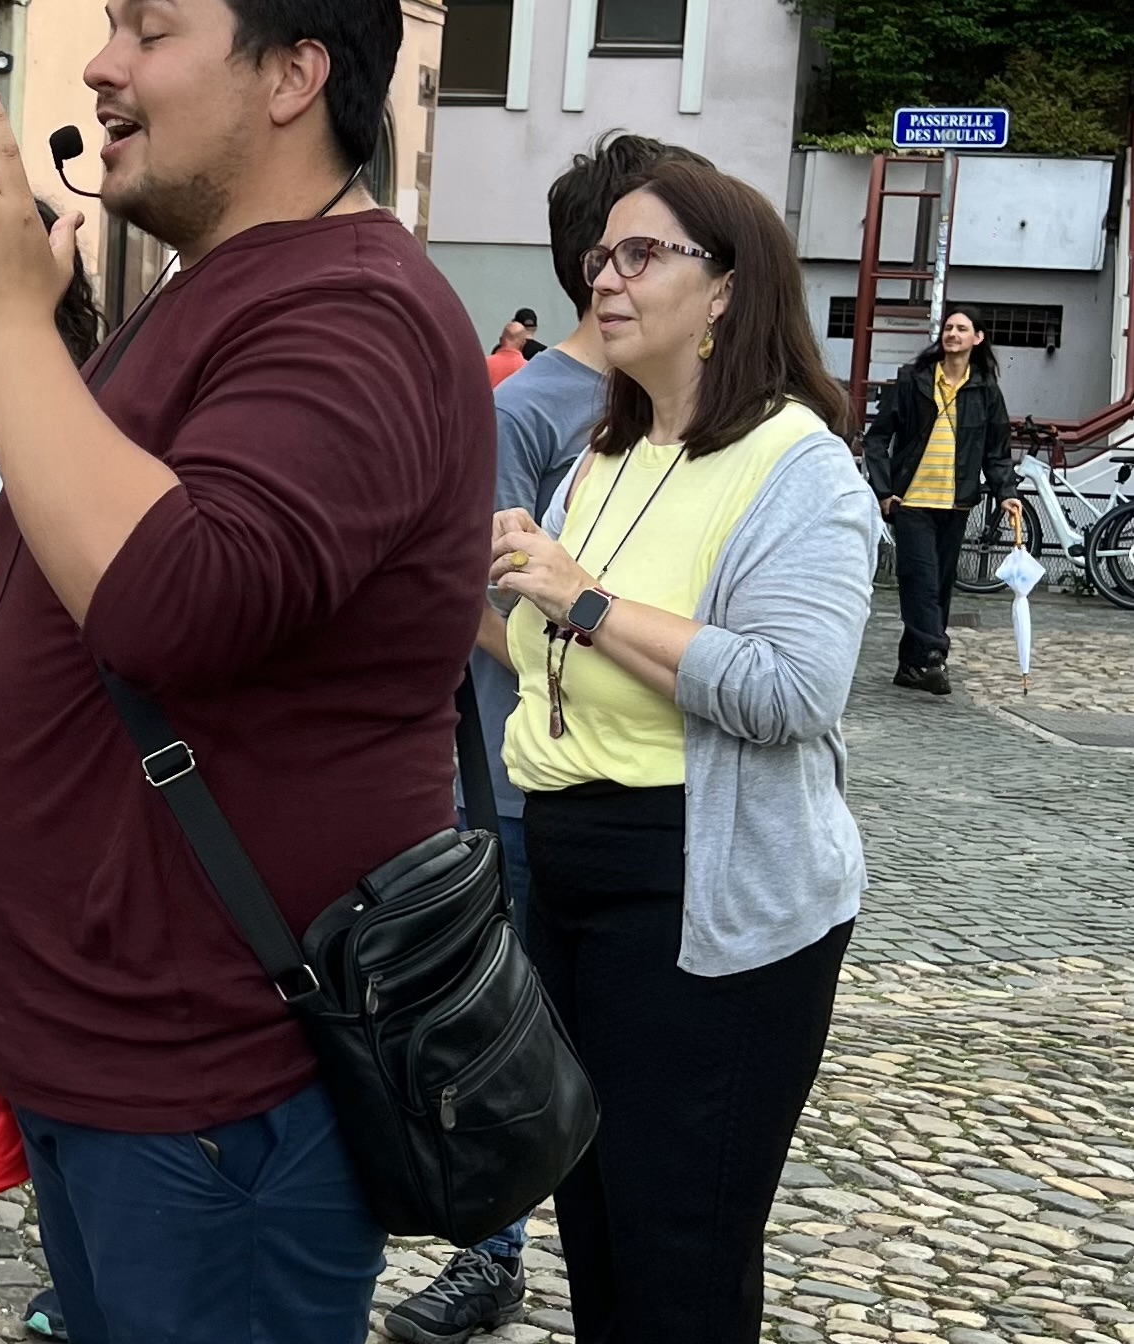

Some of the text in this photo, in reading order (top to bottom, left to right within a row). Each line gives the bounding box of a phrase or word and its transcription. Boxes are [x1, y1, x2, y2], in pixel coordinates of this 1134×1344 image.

[910, 114, 994, 127] PASSERELLE
[905, 128, 996, 142] DES MOULINS
